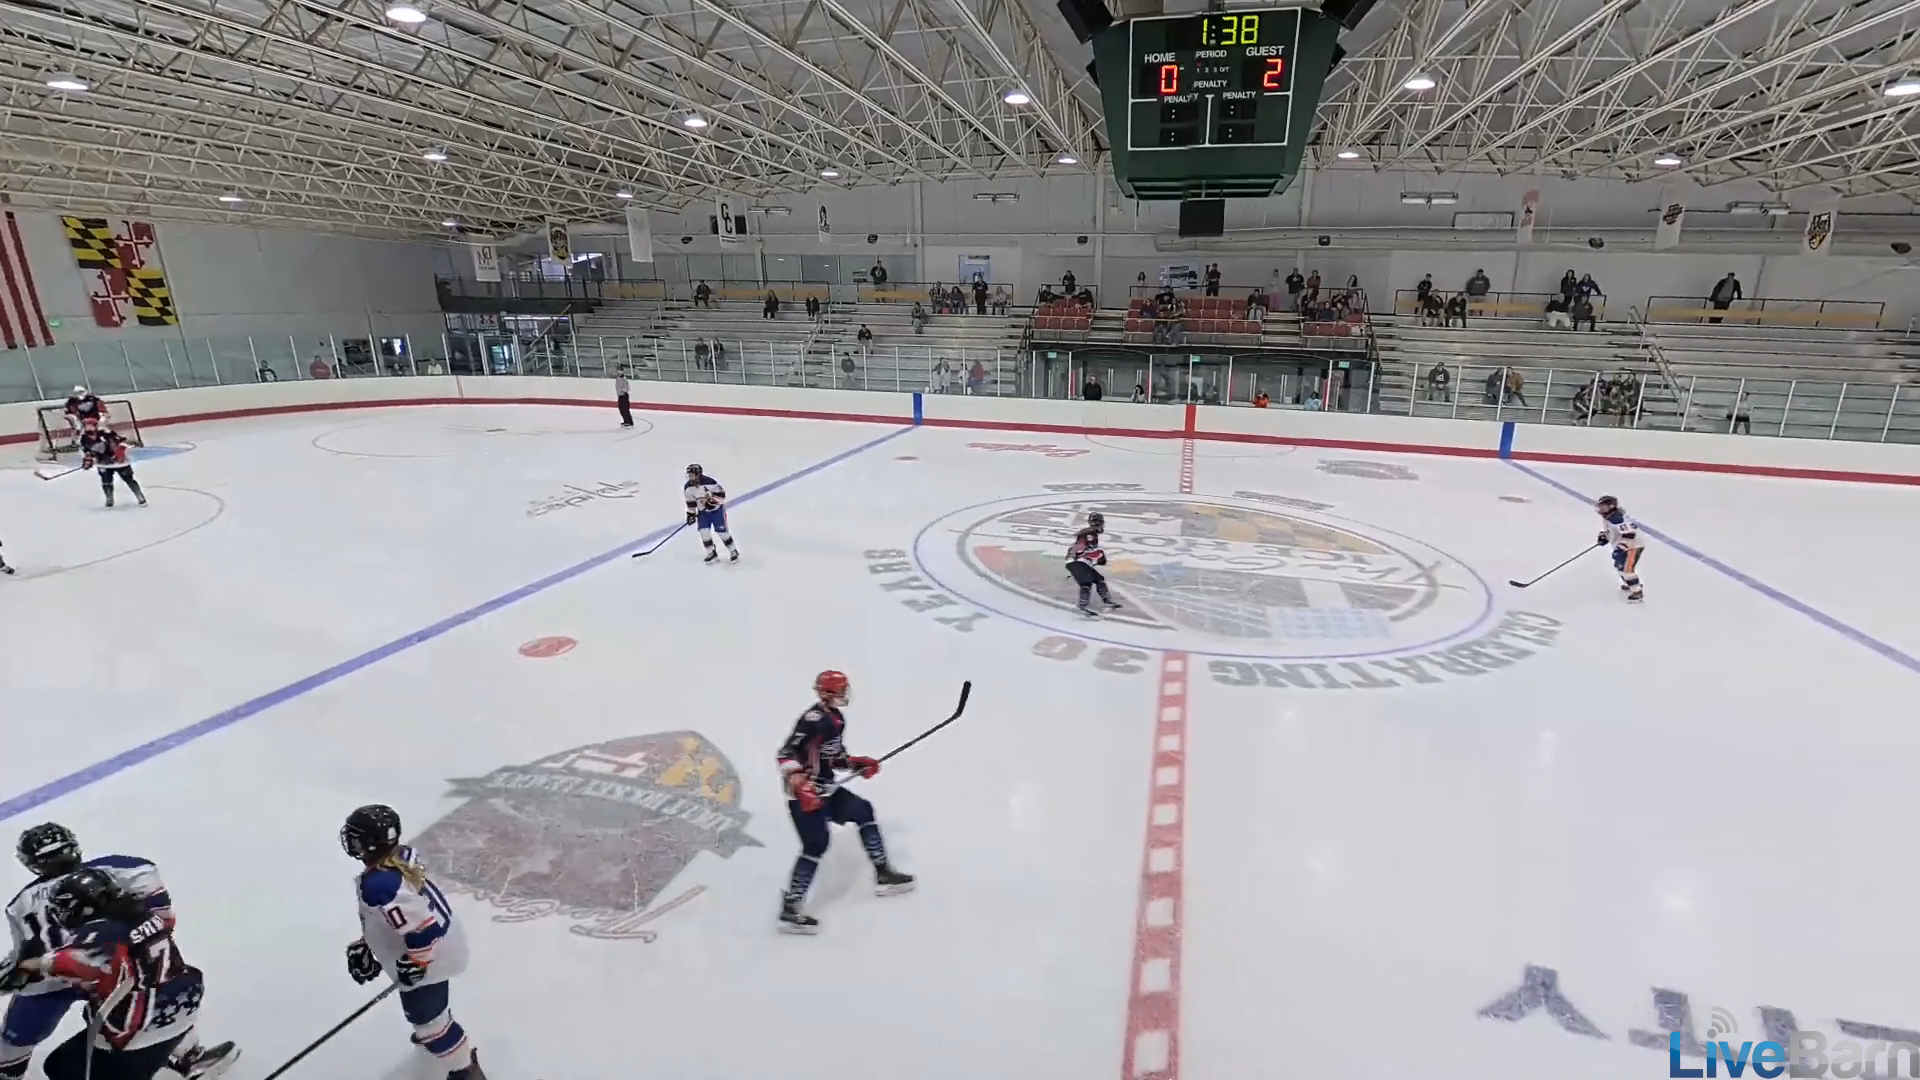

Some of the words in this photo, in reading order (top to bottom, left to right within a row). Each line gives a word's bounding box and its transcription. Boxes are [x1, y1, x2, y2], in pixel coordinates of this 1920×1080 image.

[1202, 15, 1259, 45] 1:38
[1144, 53, 1176, 63] HOME
[1195, 50, 1227, 58] PERIOD
[1246, 46, 1285, 56] GUEST
[1160, 64, 1178, 93] 0
[1193, 80, 1228, 88] PENALTY
[1263, 58, 1282, 87] 2
[1223, 91, 1257, 99] PENALTY
[862, 548, 989, 635] YEARS
[1031, 635, 1152, 676] 30
[1207, 610, 1563, 690] CELEBRATING
